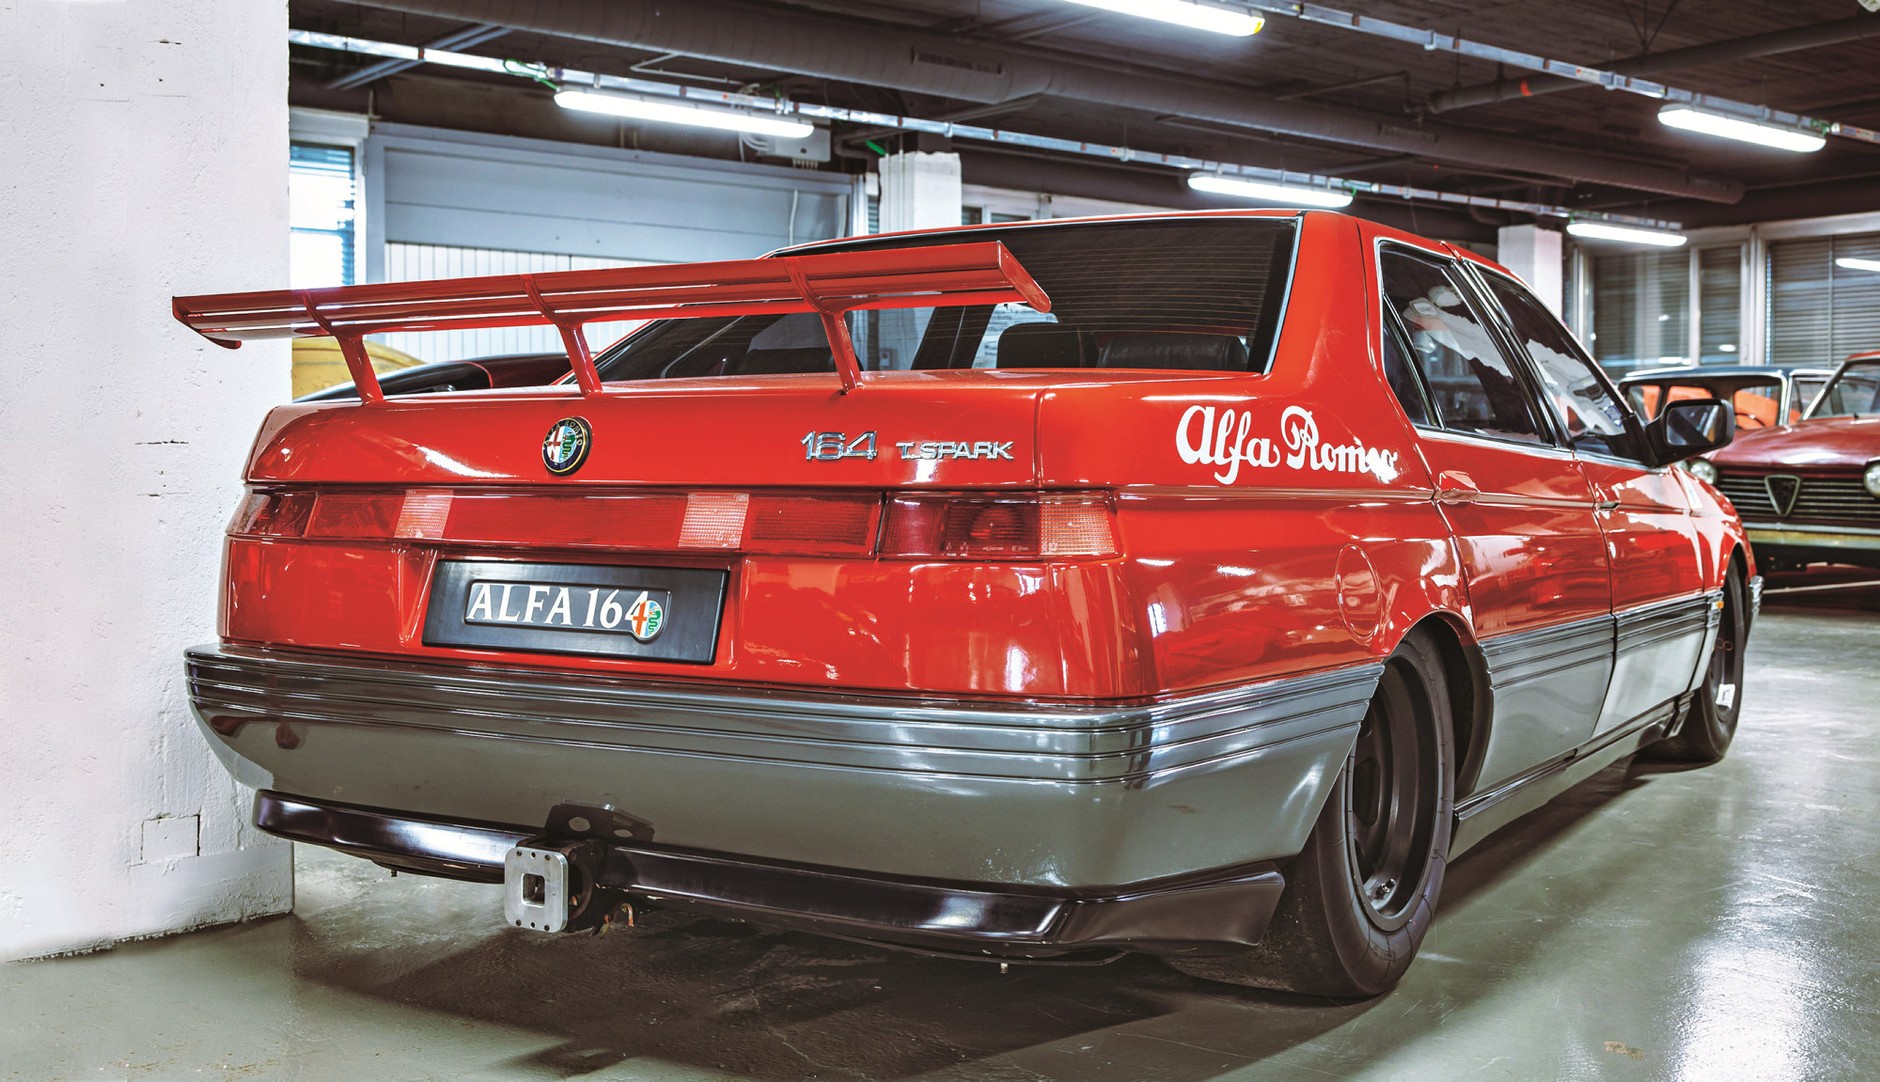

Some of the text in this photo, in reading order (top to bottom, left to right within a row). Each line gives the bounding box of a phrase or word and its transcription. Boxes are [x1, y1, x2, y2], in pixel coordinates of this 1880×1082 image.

[800, 430, 878, 460] 164
[1175, 405, 1281, 485] Alfa
[466, 583, 649, 629] ALFA 164
